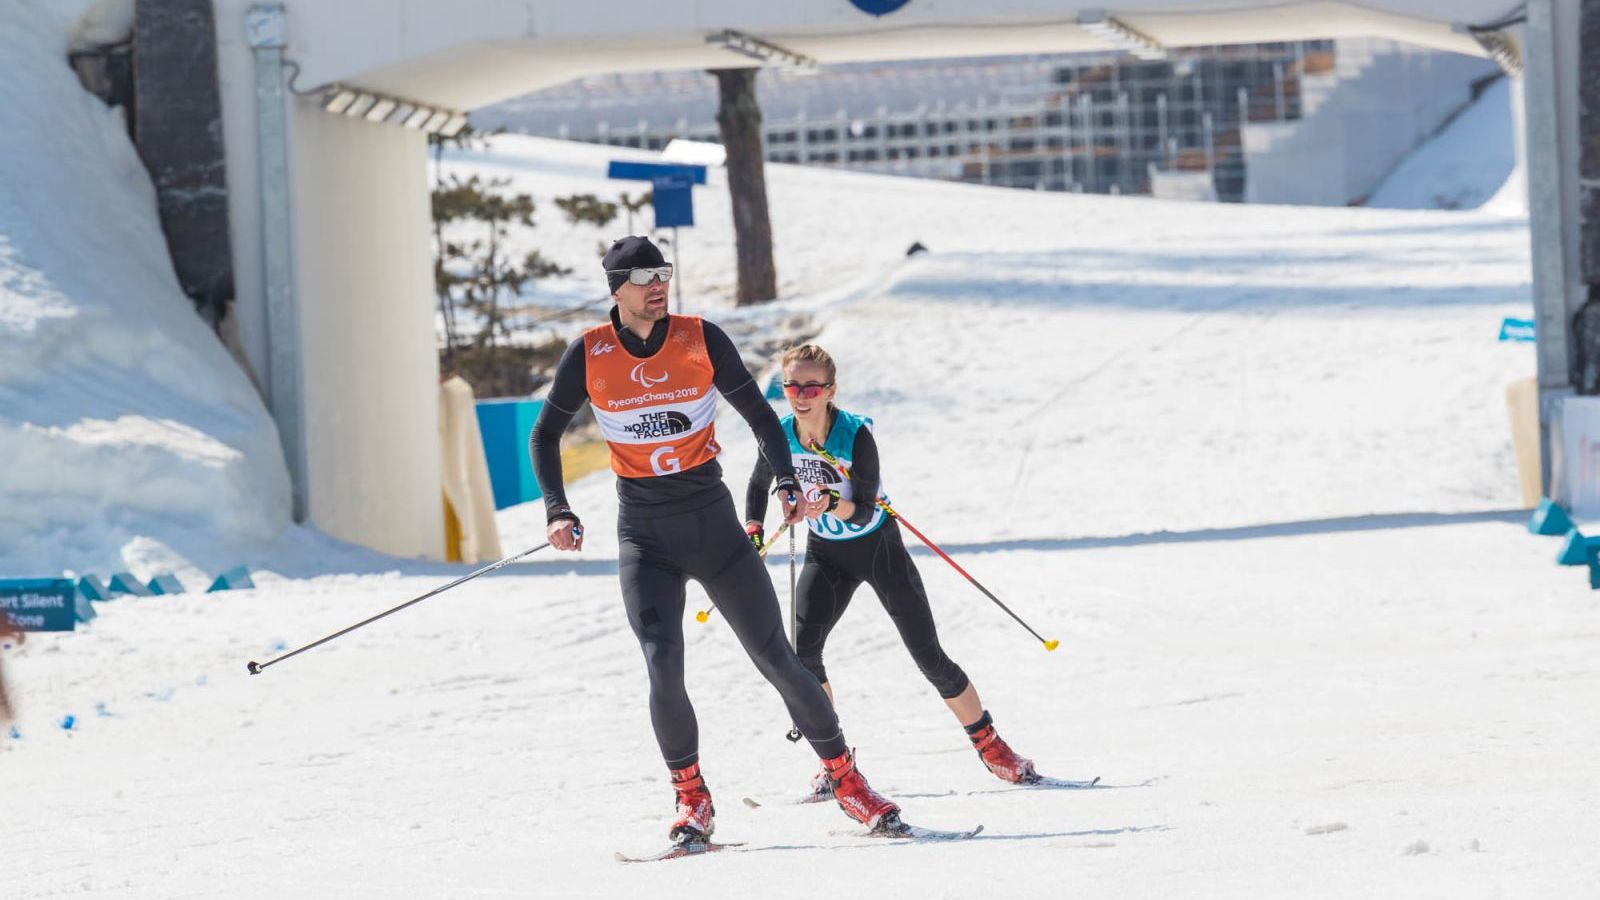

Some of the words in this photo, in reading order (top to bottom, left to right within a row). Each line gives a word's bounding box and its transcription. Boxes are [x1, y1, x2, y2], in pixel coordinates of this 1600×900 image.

[608, 391, 675, 409] PyeongChang
[676, 387, 698, 398] 2018
[639, 411, 668, 422] THE
[624, 420, 669, 433] NORTH
[637, 428, 670, 440] FACE
[650, 446, 681, 476] G
[800, 458, 821, 468] THE
[793, 466, 821, 476] ORTH
[799, 475, 823, 485] FACE
[21, 593, 65, 609] Silent
[7, 612, 45, 627] Zone
